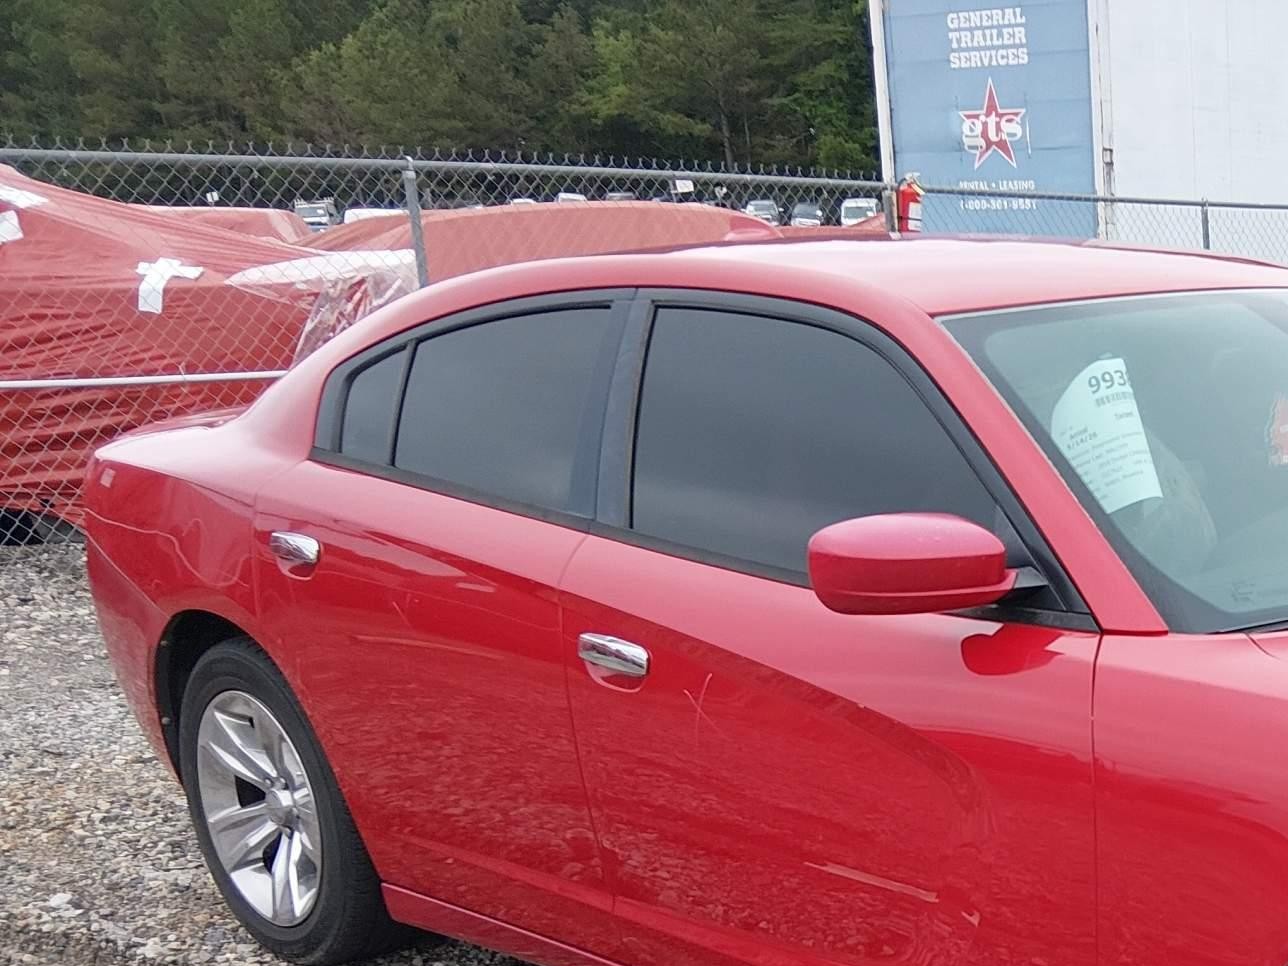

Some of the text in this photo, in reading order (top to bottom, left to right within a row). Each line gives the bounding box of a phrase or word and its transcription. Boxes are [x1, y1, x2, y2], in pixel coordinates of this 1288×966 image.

[947, 8, 1026, 28] GENERAL
[948, 27, 1027, 49] TRAILER
[949, 47, 1029, 69] SERVICES
[961, 111, 1023, 154] gts
[998, 179, 1036, 191] LEASING
[1087, 369, 1130, 395] 993
